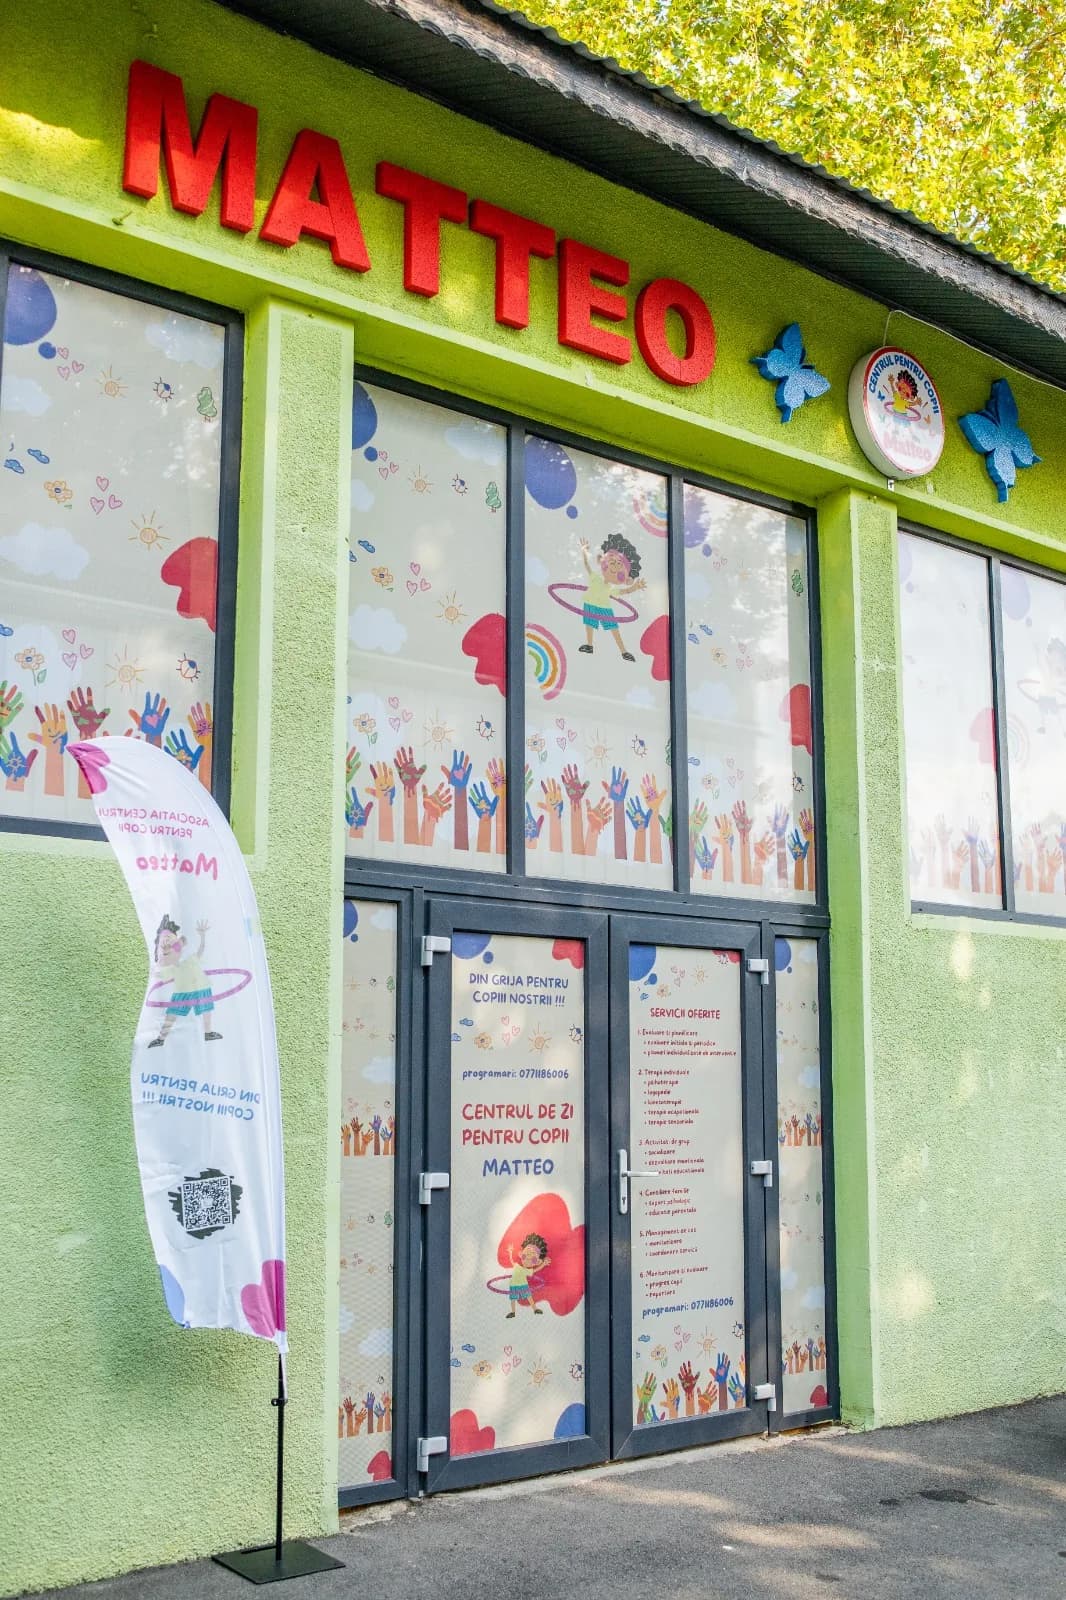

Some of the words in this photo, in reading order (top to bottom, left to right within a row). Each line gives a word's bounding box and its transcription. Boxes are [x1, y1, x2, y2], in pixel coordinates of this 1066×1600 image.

[123, 59, 716, 387] MATTEO
[868, 355, 895, 394] CENTRUL
[895, 354, 924, 381] PENTRU
[923, 380, 940, 414] COPII
[469, 973, 488, 984] DIN
[492, 974, 523, 986] GRIJA
[526, 975, 569, 989] PENTRU
[472, 990, 507, 1004] COPIII
[509, 992, 552, 1006] NOSTRII
[555, 995, 566, 1007] !!!
[650, 1007, 686, 1019] SERVICII
[687, 1008, 721, 1020] OFERITE
[462, 1069, 517, 1080] programari:
[462, 1103, 534, 1120] CENTRUL
[538, 1103, 556, 1119] DE
[560, 1102, 574, 1120] ZI
[462, 1128, 524, 1146] PENTRU
[528, 1127, 569, 1145] COPII
[482, 1158, 554, 1177] MATTEO
[642, 1302, 689, 1319] programari:
